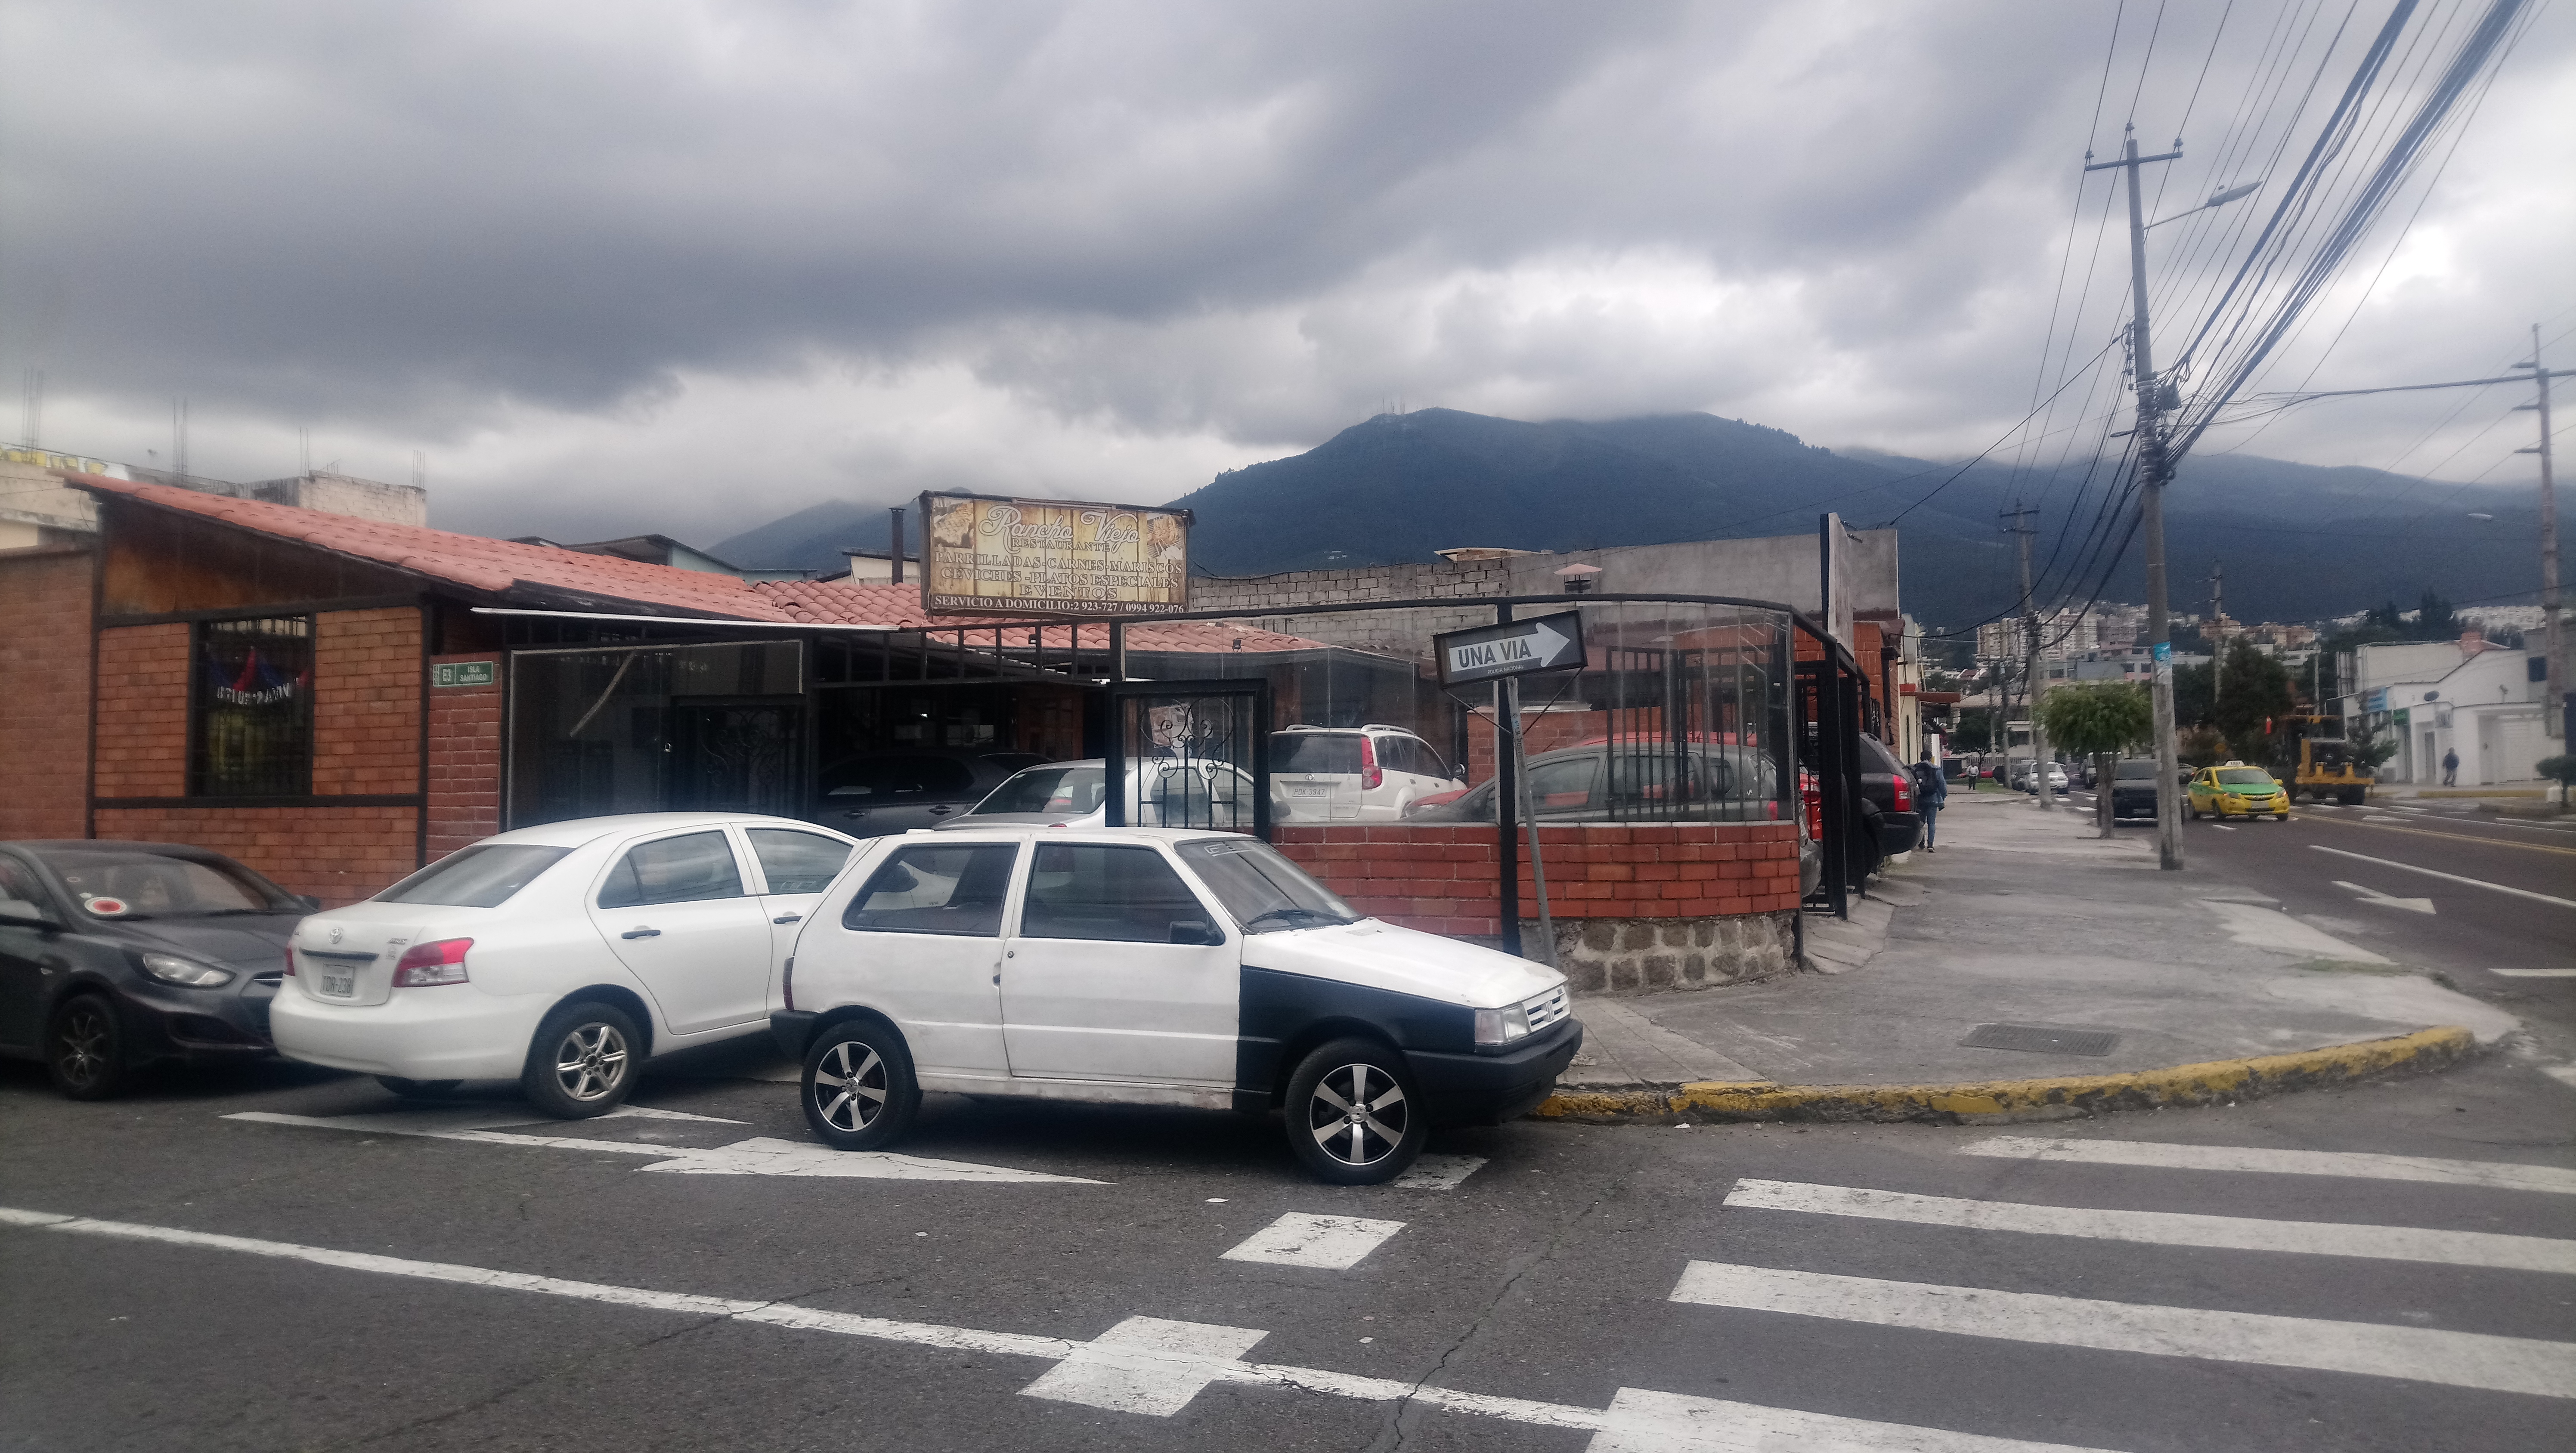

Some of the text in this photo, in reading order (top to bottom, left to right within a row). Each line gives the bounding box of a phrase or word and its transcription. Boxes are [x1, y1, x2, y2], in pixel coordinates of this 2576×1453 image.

[978, 505, 1140, 554] Rancho Viejo
[1012, 538, 1111, 552] RESTAURANTE
[941, 567, 1022, 582] CEVICHES
[1090, 574, 1179, 588] ESPECIALES
[1019, 584, 1118, 599] EVENTOS
[935, 595, 993, 607] SERVICIO
[995, 599, 1003, 608] A
[1082, 602, 1118, 612] 923-727
[1126, 603, 1147, 612] 0994
[1149, 604, 1184, 613] 922-076
[1458, 639, 1532, 668] UNA VIA
[443, 668, 451, 681] E3
[460, 674, 487, 682] SANTIAGO
